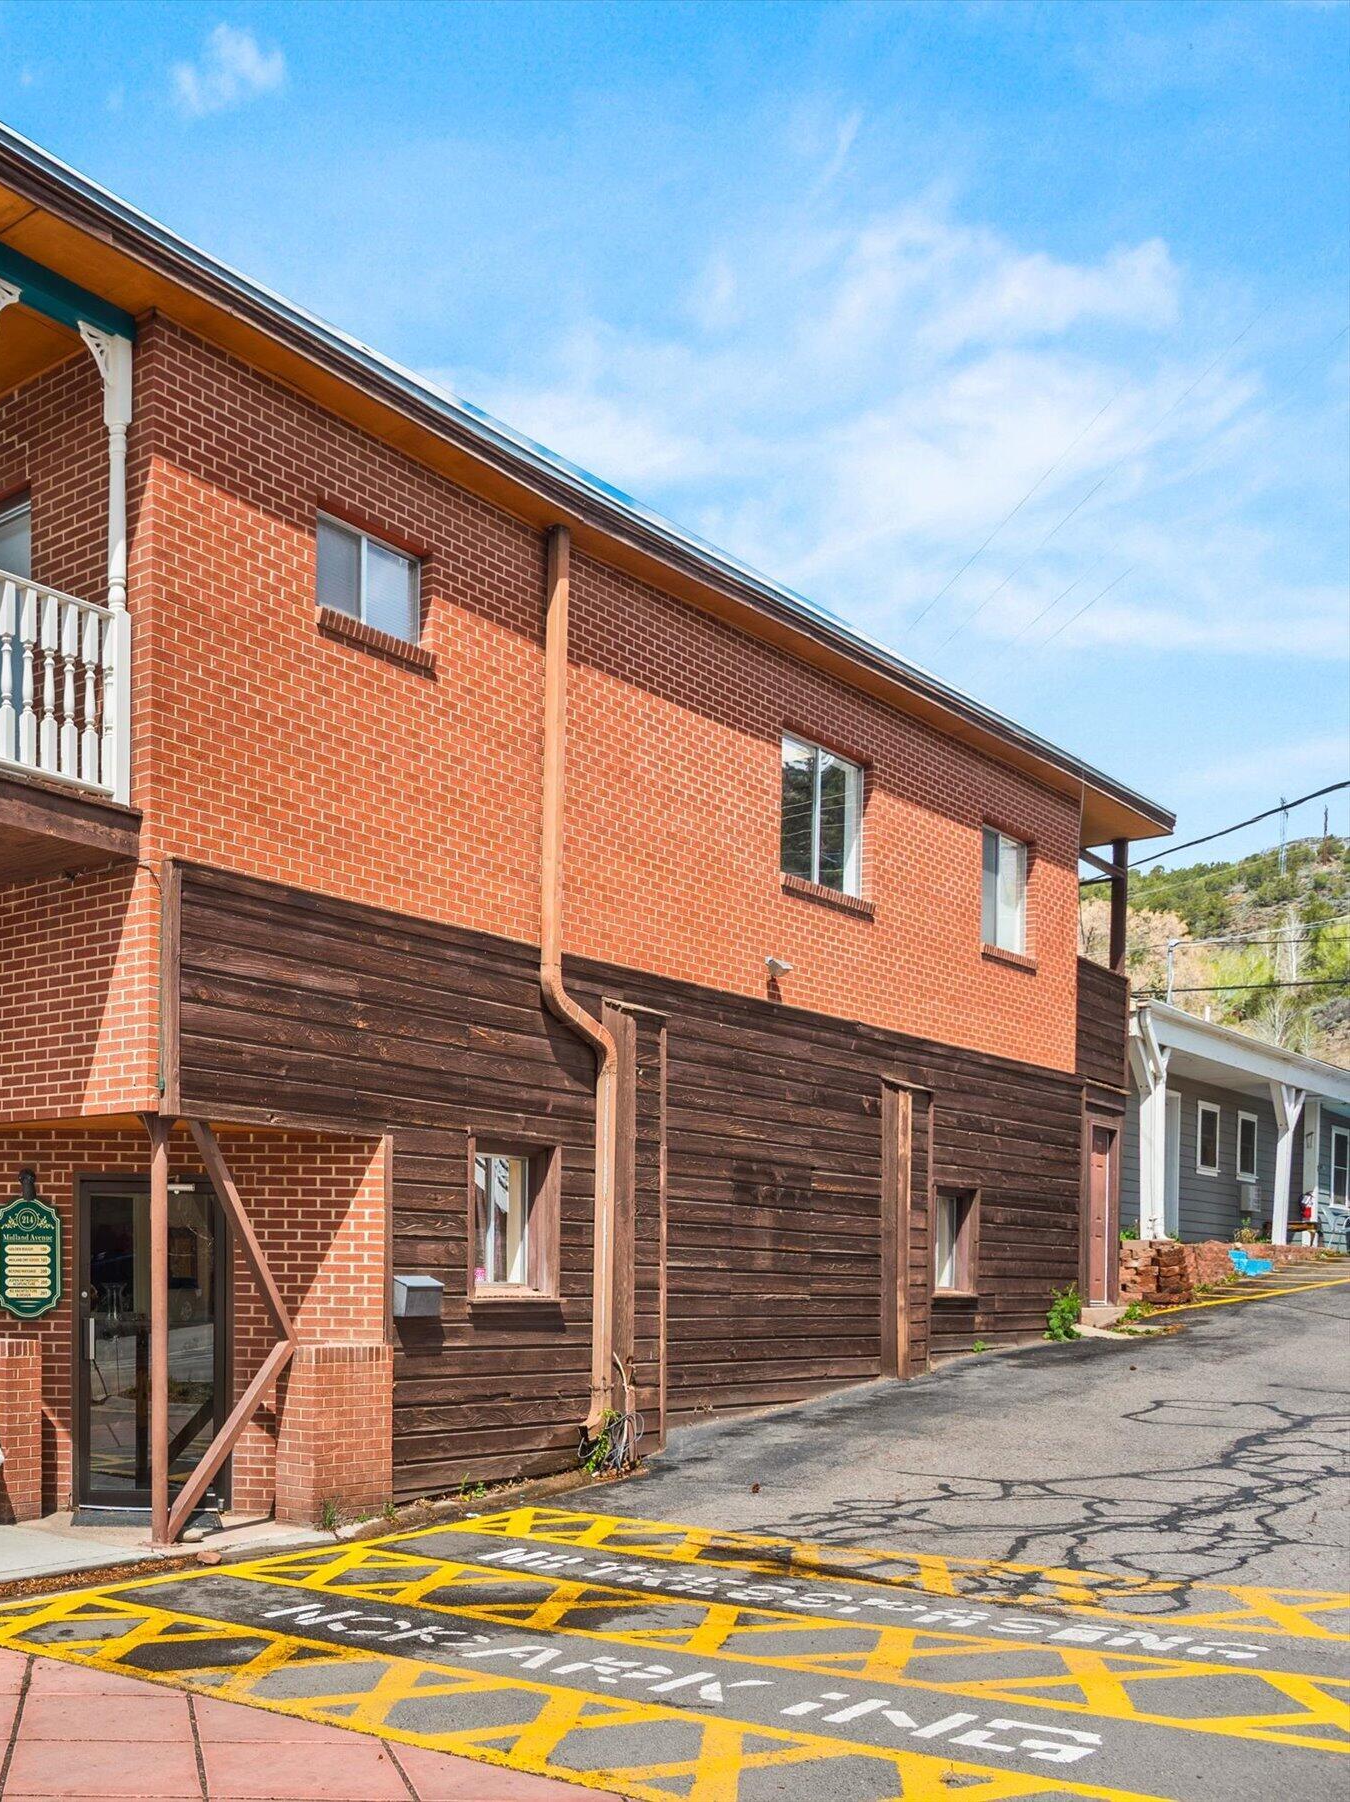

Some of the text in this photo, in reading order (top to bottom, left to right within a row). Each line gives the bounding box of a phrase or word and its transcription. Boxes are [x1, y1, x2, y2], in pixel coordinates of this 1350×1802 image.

[21, 1215, 34, 1224] 214
[3, 1233, 53, 1242] Midland Avenue
[263, 1603, 412, 1635] NO
